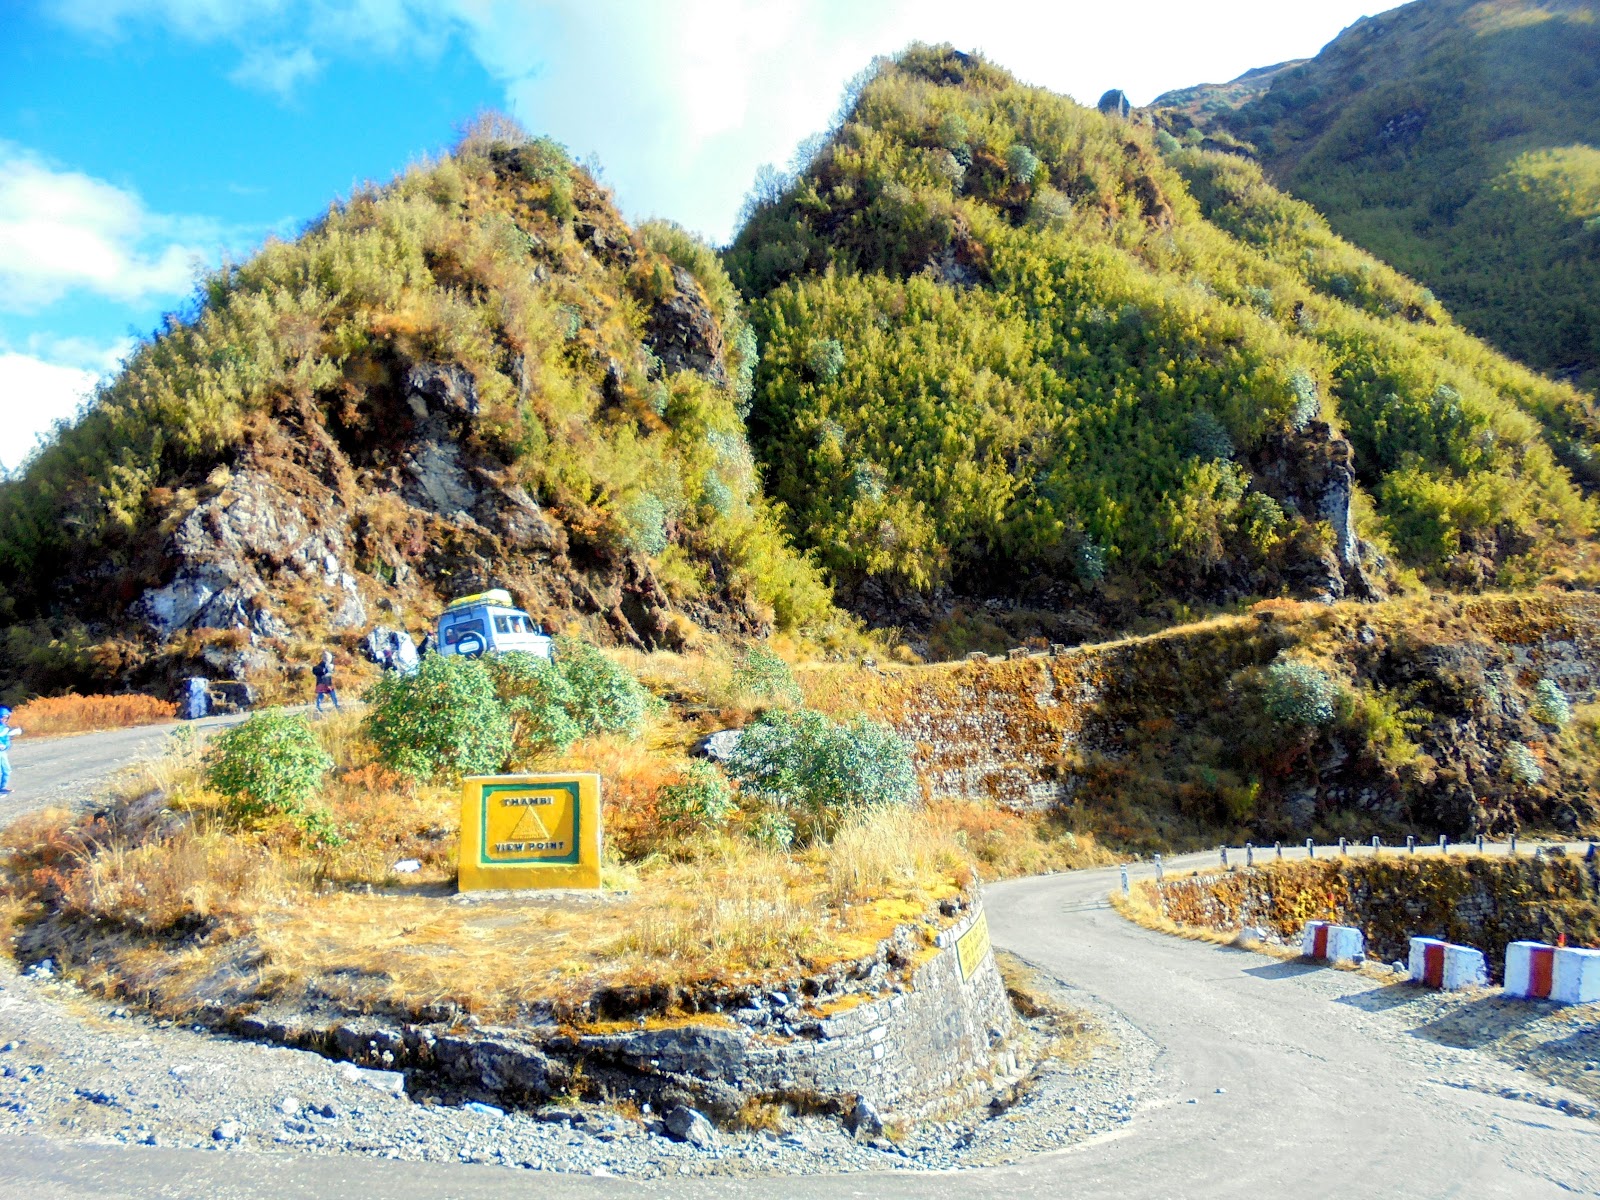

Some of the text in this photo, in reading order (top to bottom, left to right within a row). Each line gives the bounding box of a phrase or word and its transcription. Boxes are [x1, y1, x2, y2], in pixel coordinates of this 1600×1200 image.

[503, 797, 553, 806] THAMBI
[496, 841, 564, 853] VIEW POINT
